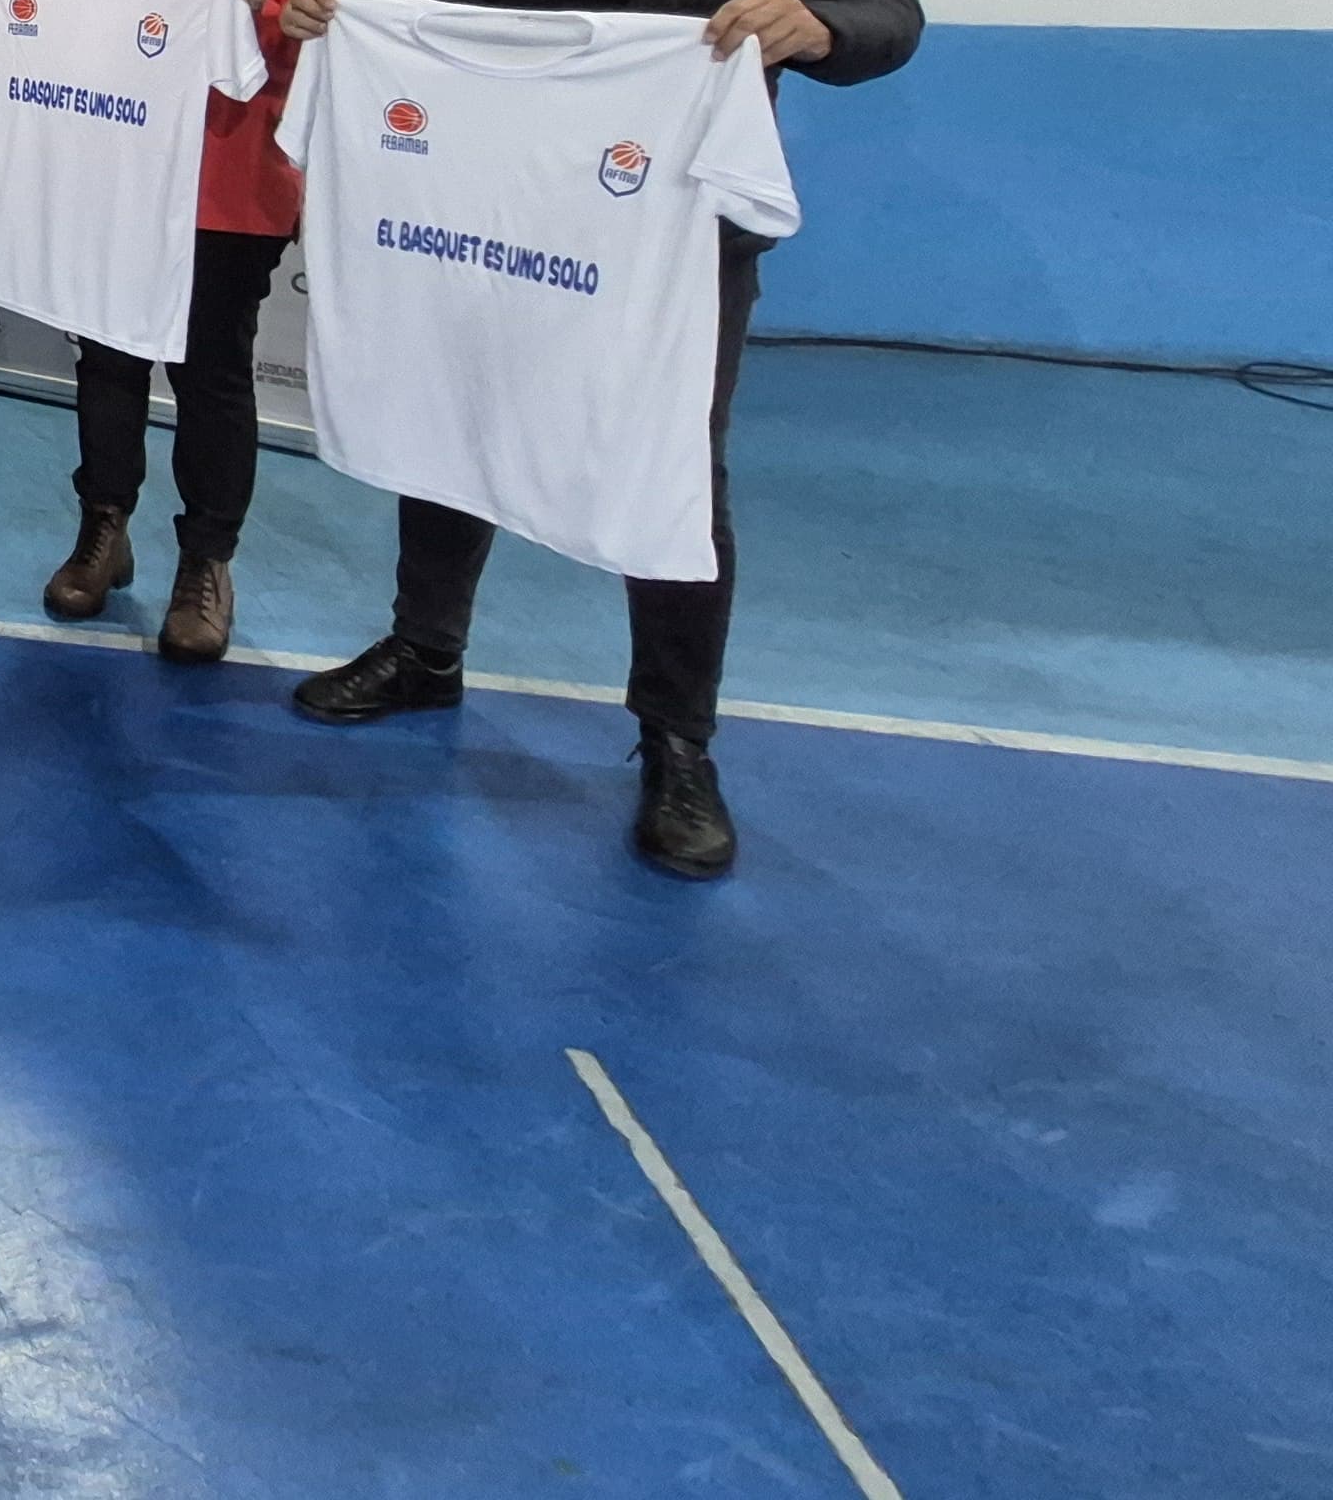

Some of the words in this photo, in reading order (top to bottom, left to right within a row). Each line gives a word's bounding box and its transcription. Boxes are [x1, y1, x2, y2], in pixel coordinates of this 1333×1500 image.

[8, 76, 21, 101] EL
[22, 78, 74, 110] BASQUET
[74, 88, 88, 114] ES
[89, 91, 114, 120] UNO
[115, 97, 147, 127] SOLO
[381, 134, 429, 155] FEBAMBA
[604, 167, 639, 184] AFMB
[377, 218, 395, 248] EL
[399, 221, 481, 264] BASQUET
[483, 239, 504, 271] ES
[506, 245, 545, 283] UNO
[548, 255, 599, 295] SOLO
